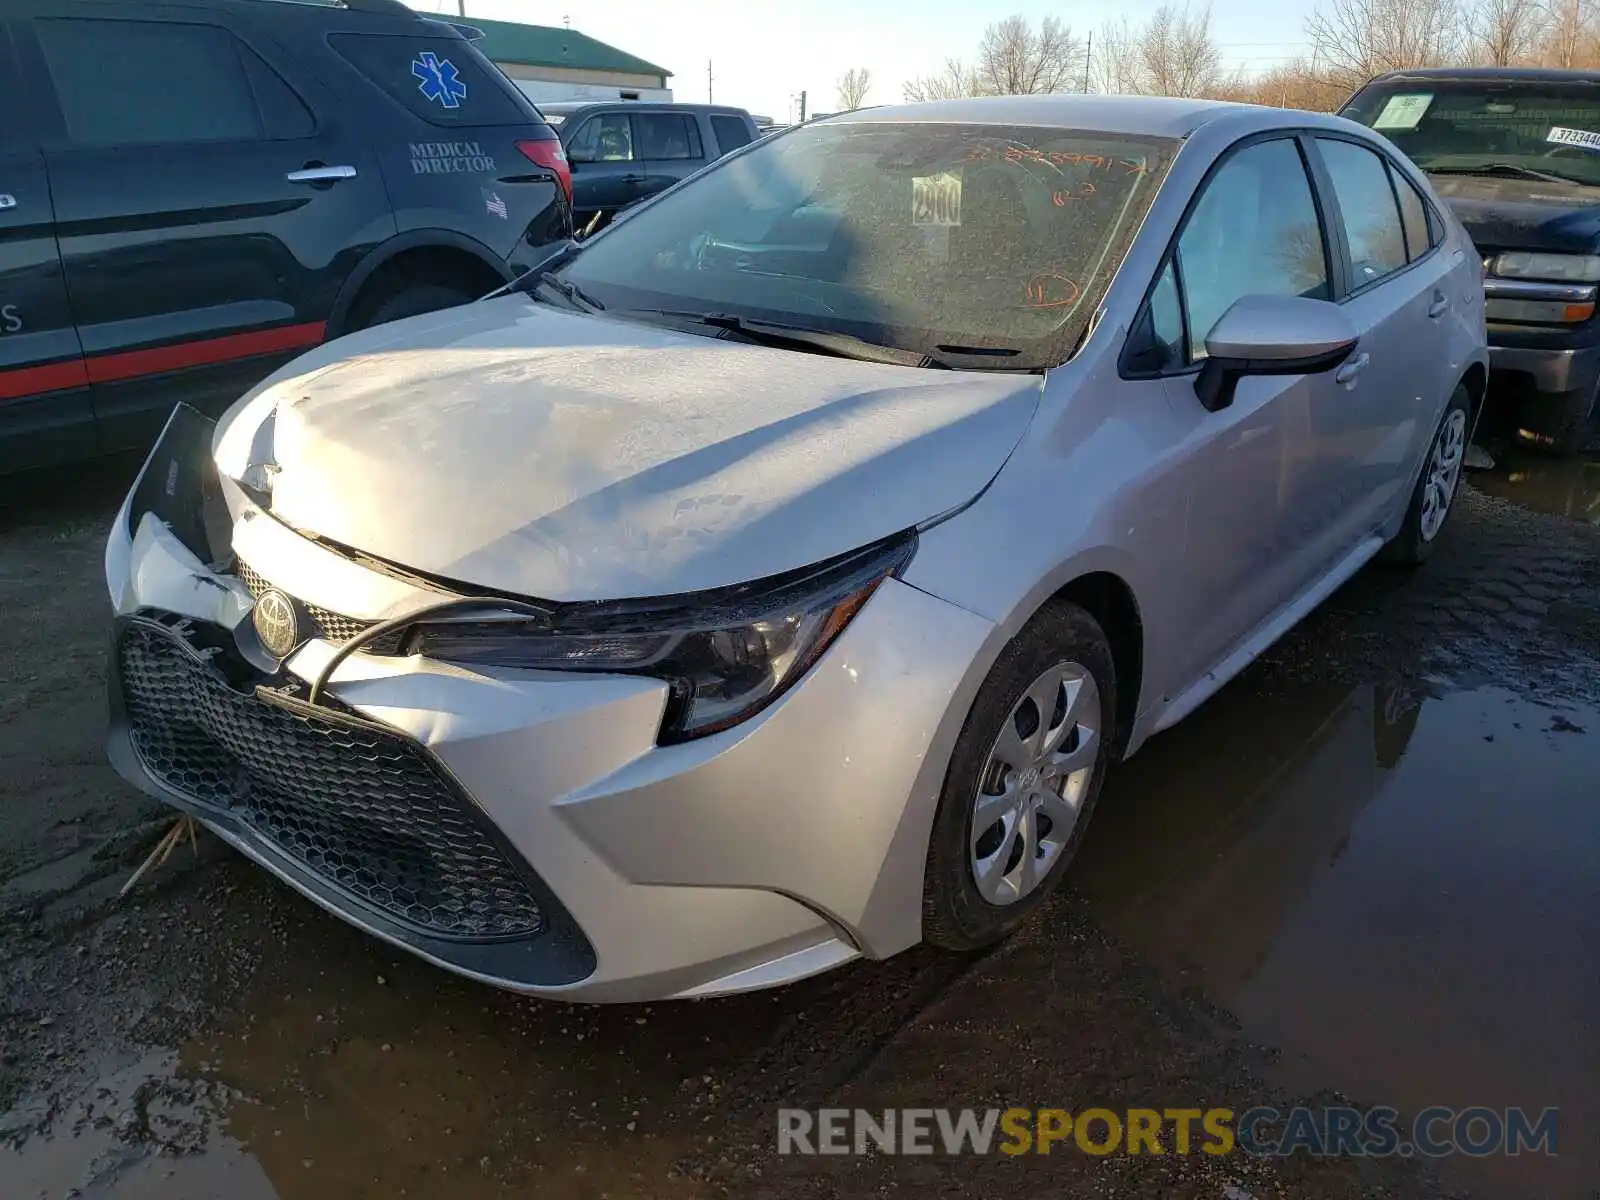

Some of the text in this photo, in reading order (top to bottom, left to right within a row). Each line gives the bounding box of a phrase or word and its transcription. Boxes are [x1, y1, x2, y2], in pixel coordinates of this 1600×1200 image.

[408, 142, 486, 158] MEDICAL
[410, 156, 497, 174] DIRECTOR
[0, 304, 22, 333] S
